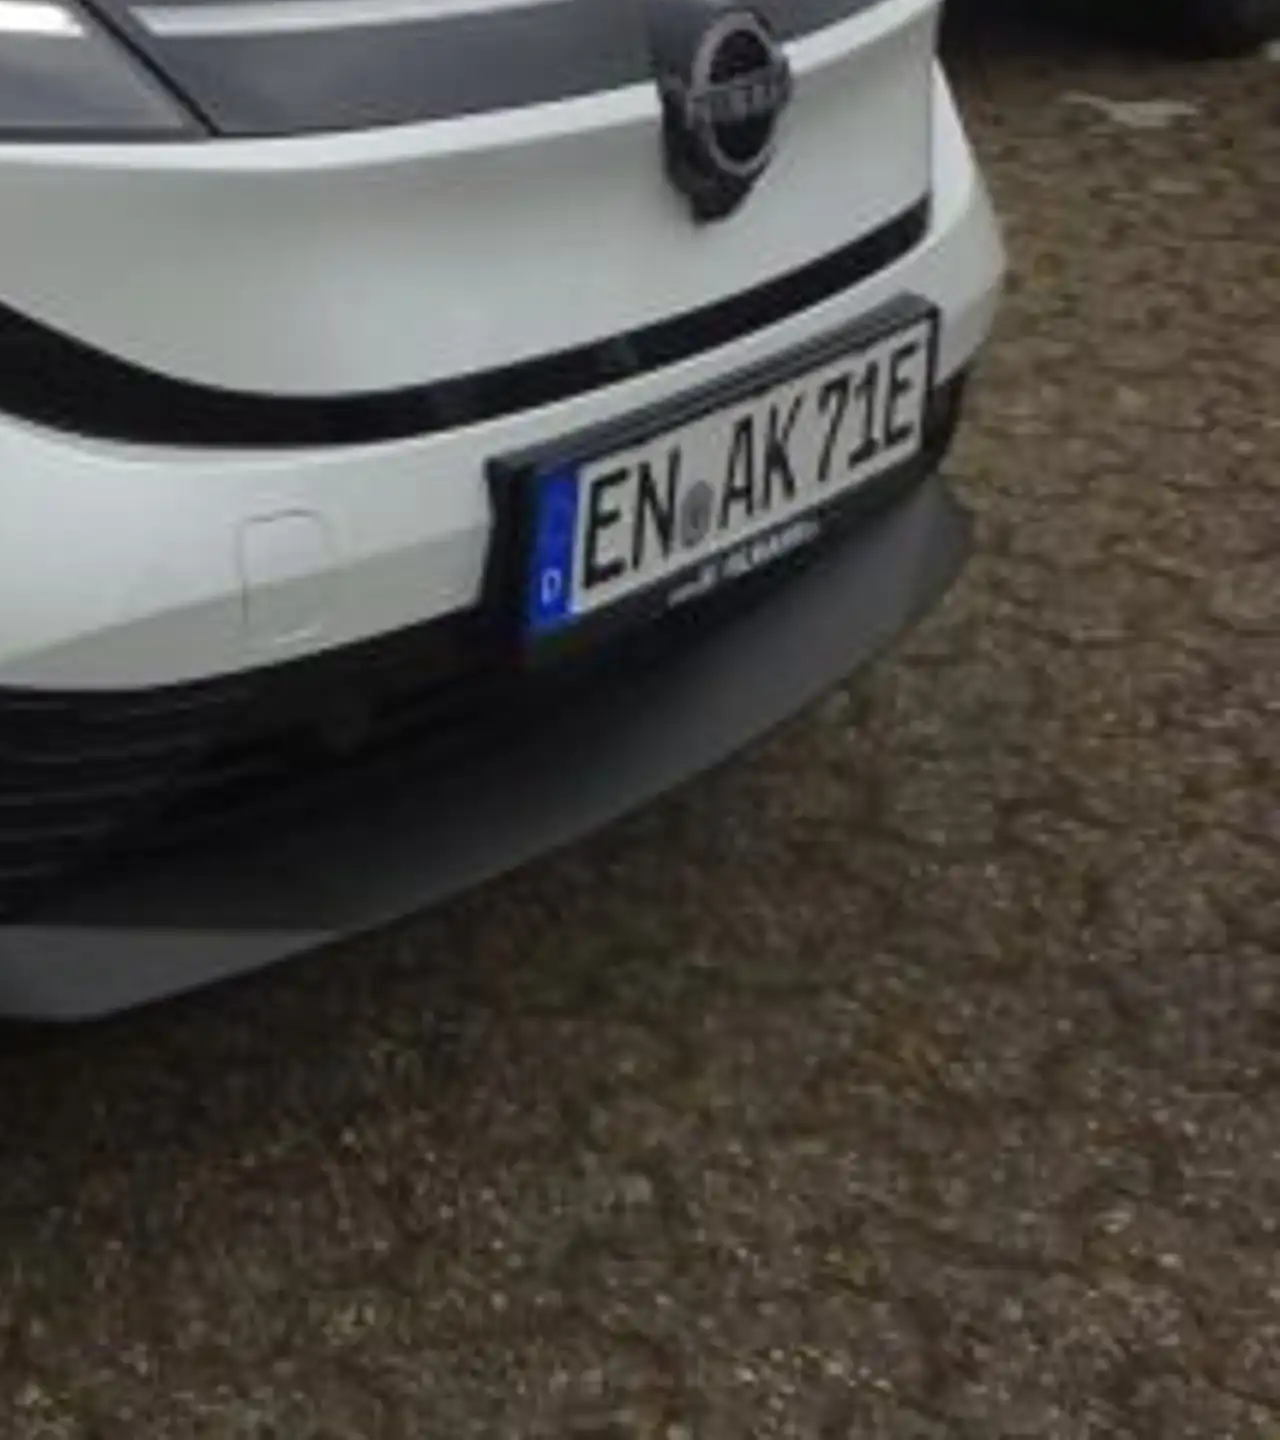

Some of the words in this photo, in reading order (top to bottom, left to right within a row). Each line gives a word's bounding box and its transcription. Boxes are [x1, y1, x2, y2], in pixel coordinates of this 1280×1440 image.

[583, 444, 682, 591] EN
[716, 394, 804, 530] AK
[816, 342, 920, 482] 71E
